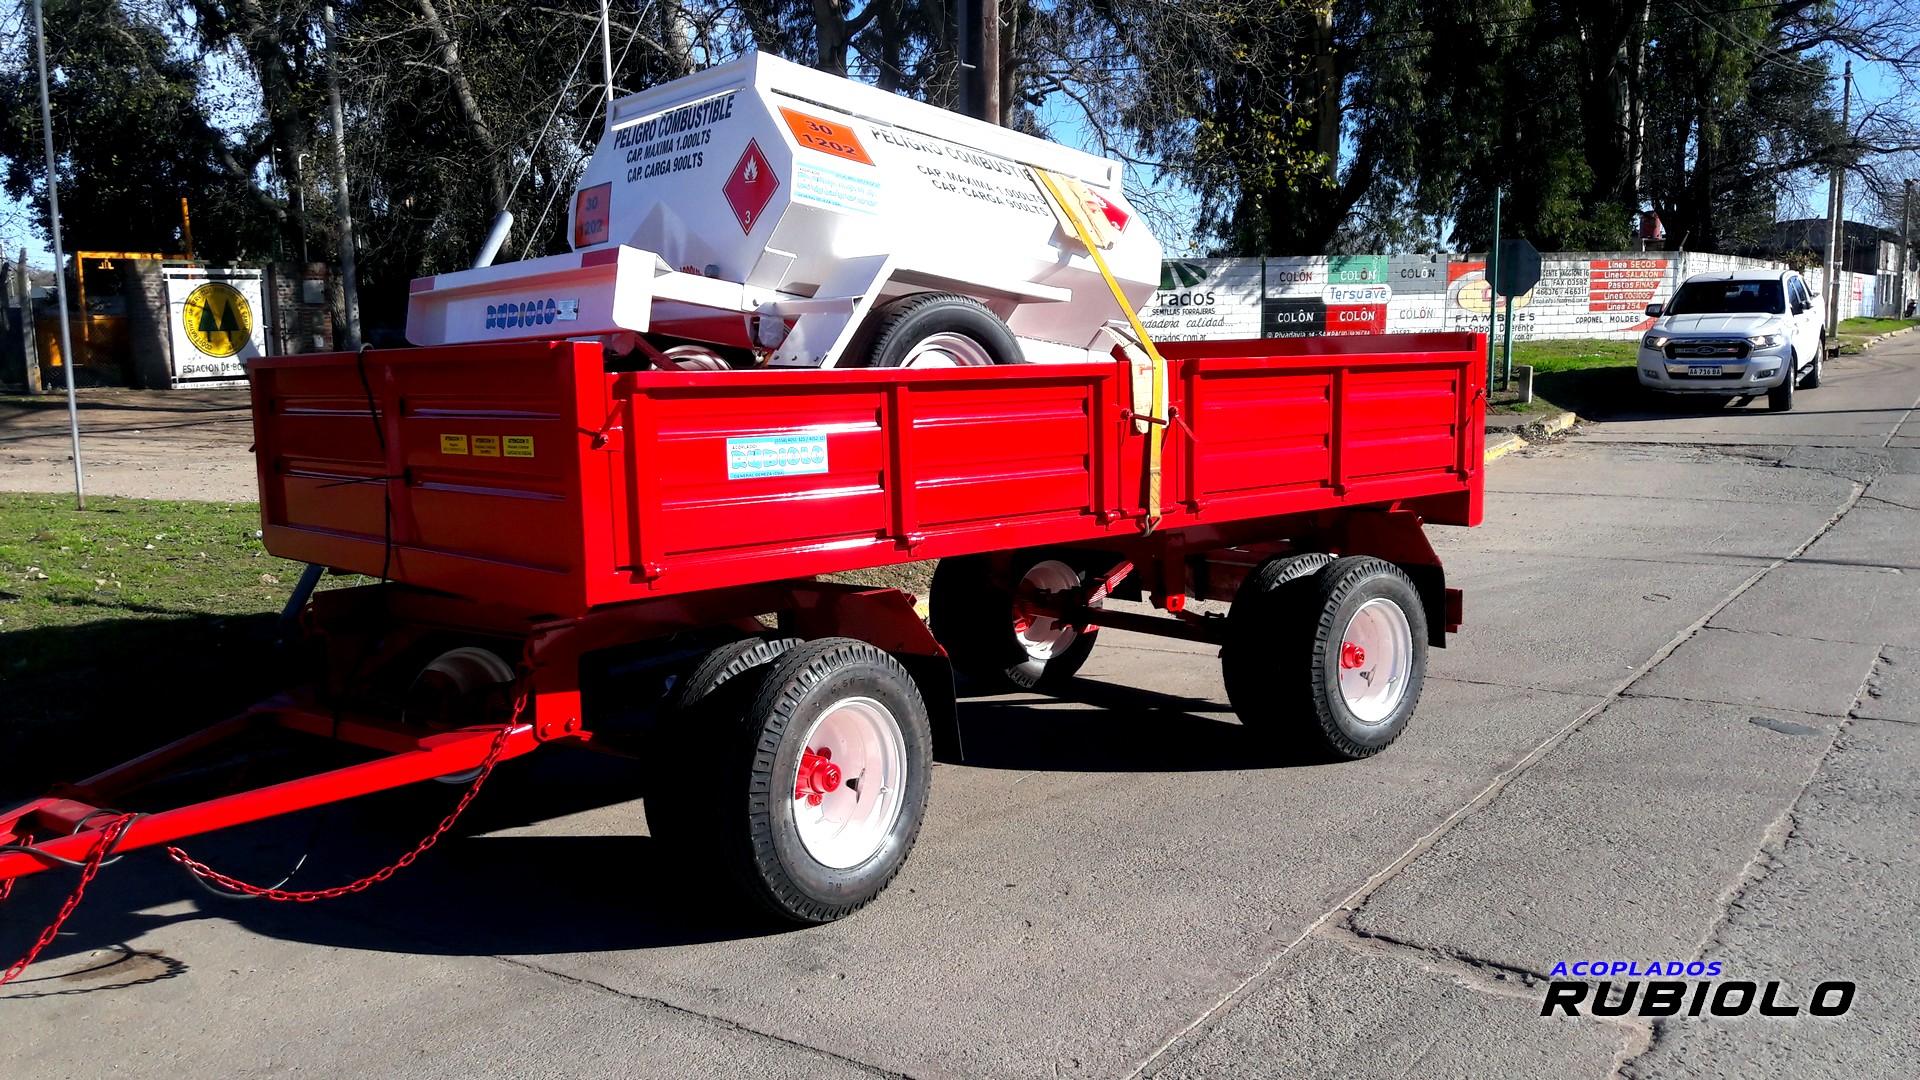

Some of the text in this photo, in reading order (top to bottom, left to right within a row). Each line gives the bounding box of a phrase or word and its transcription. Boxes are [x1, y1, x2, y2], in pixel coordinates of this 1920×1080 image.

[614, 95, 735, 150] PELIGRO COMBUSTIBLE
[805, 120, 833, 135] 30
[627, 129, 712, 164] CAP. MAXIMA 1.000LTS
[802, 133, 858, 156] 1202
[627, 152, 704, 183] CAP. CARGA 900LTS
[945, 146, 1034, 181] COMBUSTIB
[917, 165, 945, 179] CAP.
[947, 171, 995, 192] MAXIMA
[586, 196, 599, 211] 30
[932, 179, 1049, 217] CAP. CARGA 900LTS
[745, 211, 751, 224] 3
[580, 220, 604, 236] 1202
[1630, 260, 1656, 268] SECOS
[1608, 281, 1635, 289] Pastas
[1330, 286, 1388, 300] Tersuave
[1152, 308, 1216, 316] SEMILLAS FORRAJERAS
[1576, 315, 1603, 323] CORONEL
[1468, 324, 1490, 333] Sabo
[1499, 323, 1535, 332] Derente
[183, 363, 219, 374] ESTACION
[221, 363, 230, 372] DE
